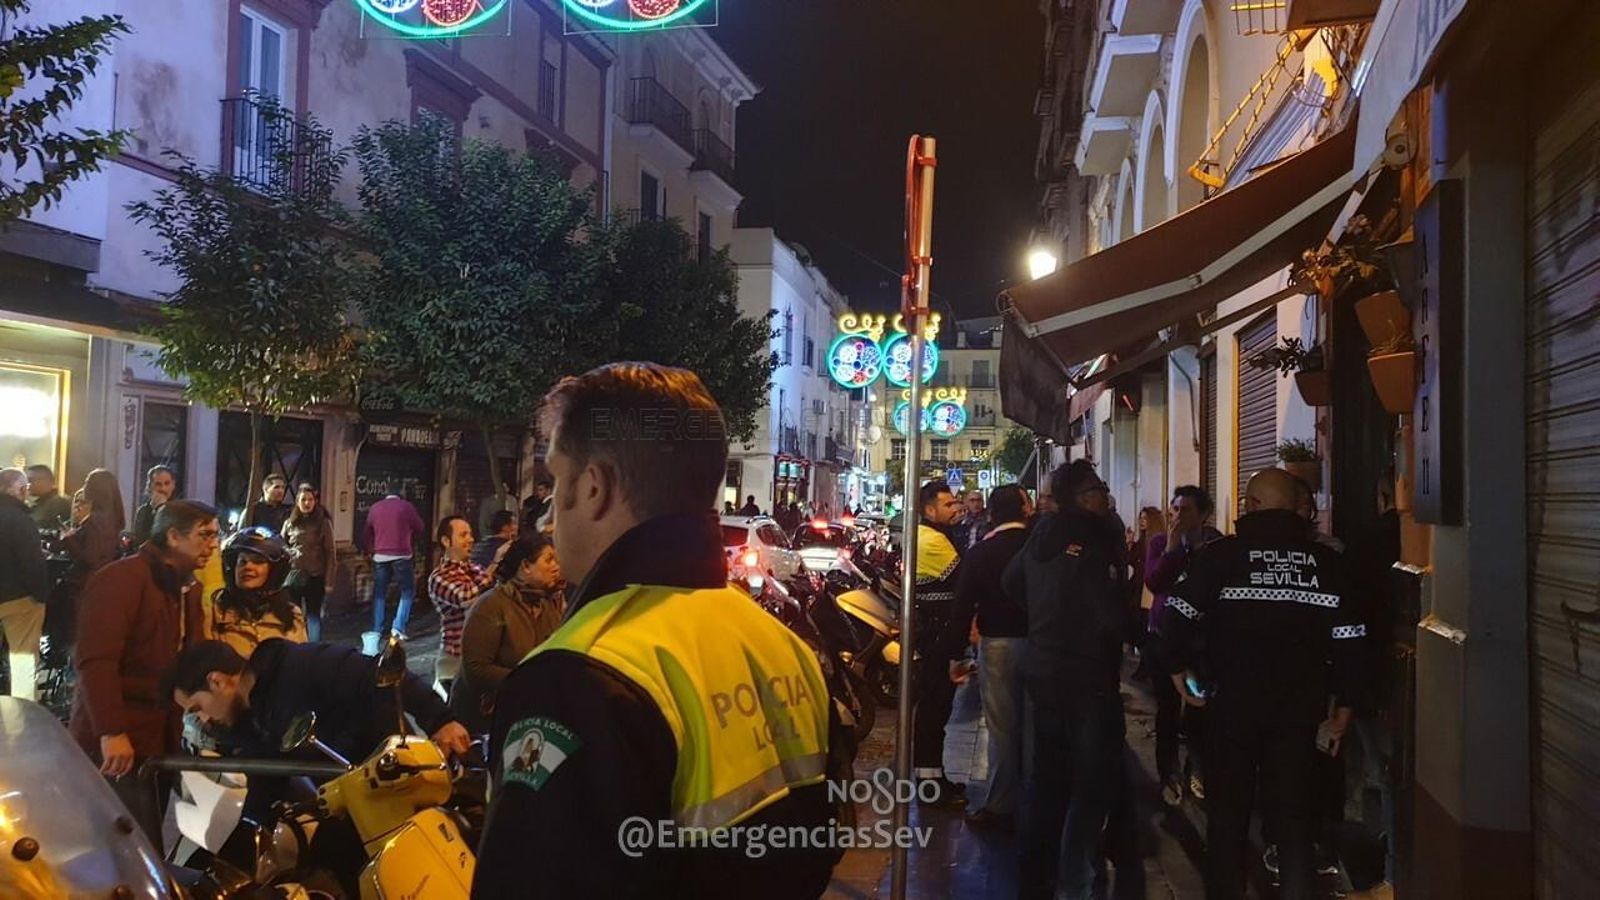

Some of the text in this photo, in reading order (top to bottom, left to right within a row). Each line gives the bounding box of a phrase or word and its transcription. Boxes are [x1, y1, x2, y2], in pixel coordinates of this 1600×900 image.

[1249, 550, 1317, 567] POLICIA
[1267, 563, 1302, 573] LOCAL
[1250, 572, 1319, 589] SEVILLA
